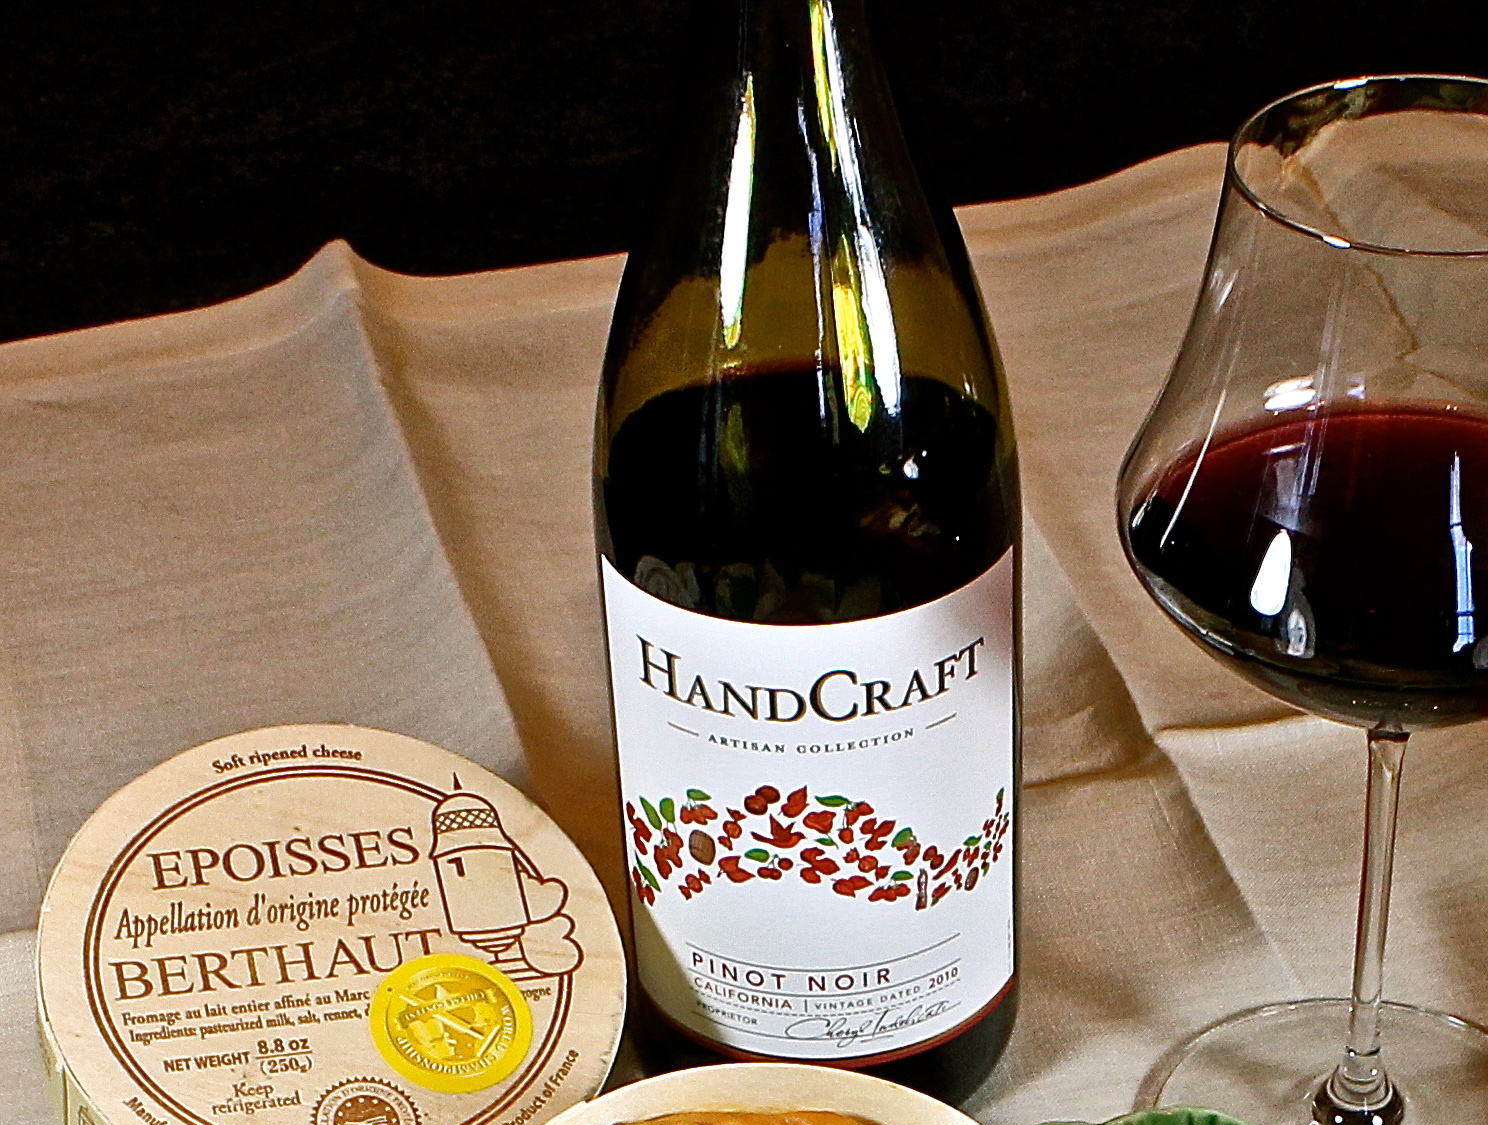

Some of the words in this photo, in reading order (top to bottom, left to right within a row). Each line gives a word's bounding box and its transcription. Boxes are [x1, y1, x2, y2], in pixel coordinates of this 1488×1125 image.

[635, 633, 985, 722] HANDCRAFT
[708, 733, 785, 754] ARTISAN
[796, 727, 915, 754] COLLECTION
[212, 754, 246, 774] Soft
[248, 744, 308, 766] ripened
[312, 744, 362, 760] cheese
[146, 826, 421, 890] EPOISSES
[114, 900, 240, 949] Appellation
[247, 893, 340, 931] d'origine
[347, 881, 430, 926] protégée
[108, 928, 443, 1001] BERTHAUT
[692, 952, 787, 990] PINOT
[808, 968, 892, 993] NOIR
[694, 976, 793, 1010] CALIFORNIA
[814, 998, 872, 1010] VINTAGE
[880, 985, 920, 1003] DATED
[928, 967, 959, 990] 2010
[122, 1007, 182, 1026] Fromage
[185, 1008, 201, 1020] au
[204, 1003, 227, 1017] lait
[231, 999, 270, 1015] entier
[274, 993, 312, 1009] affiné
[315, 996, 332, 1006] au
[335, 989, 370, 1003] Marc
[199, 1018, 263, 1040] pasteurized
[163, 1057, 192, 1073] NET
[194, 1051, 250, 1071] WEIGHT
[257, 1039, 285, 1056] 8.8
[289, 1038, 310, 1051] oz
[260, 1055, 314, 1075] (250g)
[543, 1081, 557, 1098] of
[550, 1049, 580, 1087] France
[211, 1090, 302, 1115] refrigerated
[232, 1082, 274, 1099] Keep
